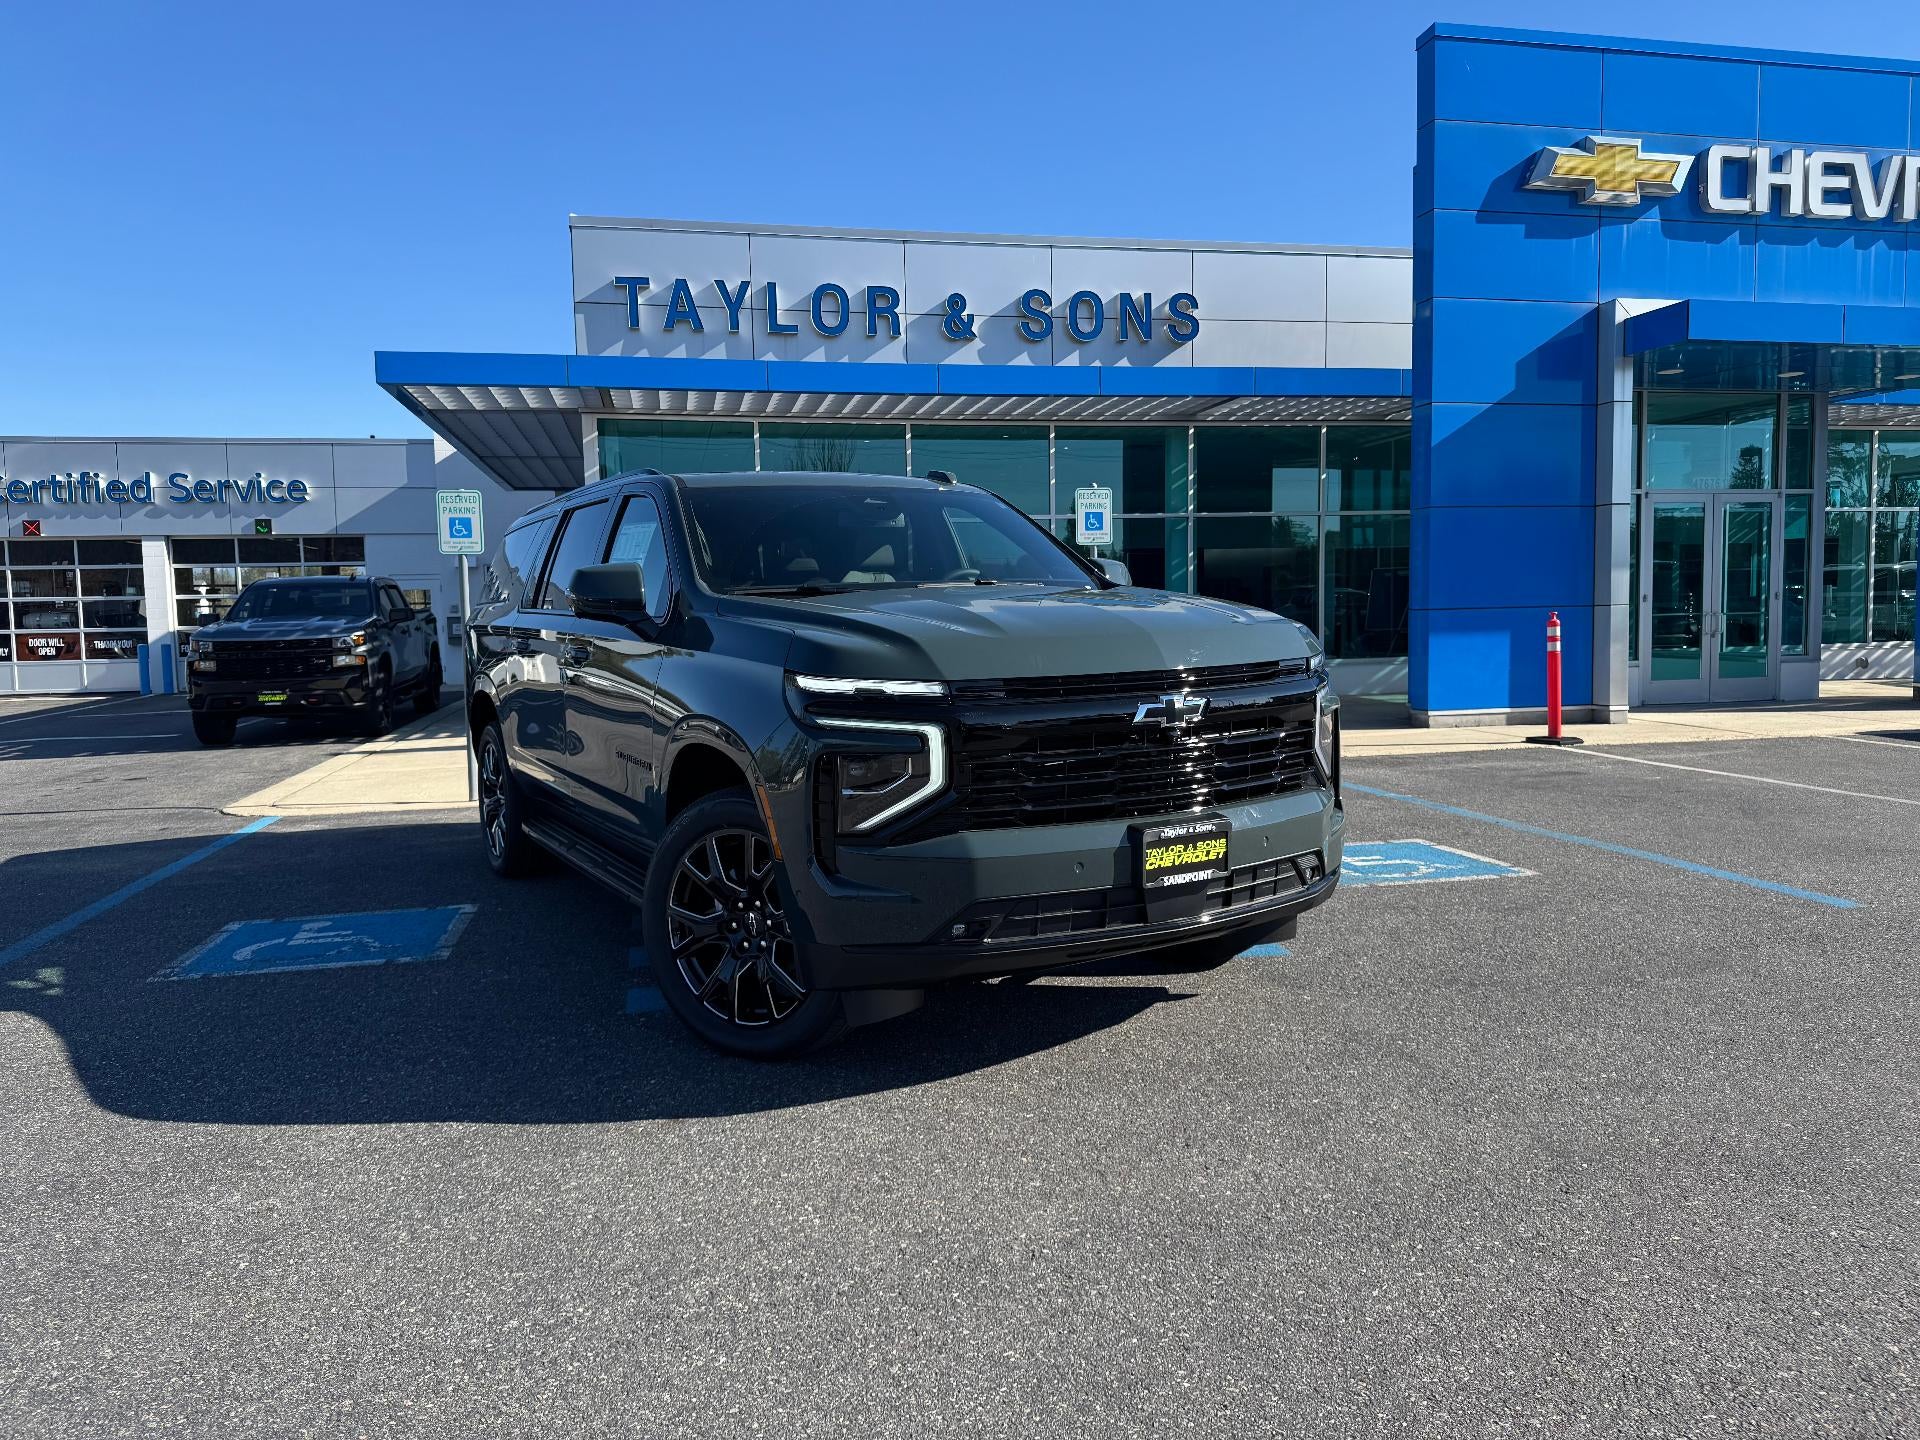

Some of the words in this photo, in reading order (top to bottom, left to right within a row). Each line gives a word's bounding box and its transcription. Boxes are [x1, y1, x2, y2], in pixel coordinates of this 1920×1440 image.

[614, 276, 901, 337] TAYLOR
[942, 292, 978, 340] &
[1017, 289, 1200, 343] SONS
[0, 471, 154, 503] ertified
[168, 472, 309, 503] Service
[440, 495, 478, 504] RESERVED
[1078, 492, 1109, 500] RESERVED
[442, 506, 476, 515] PARKING
[1080, 502, 1107, 510] PARKING
[28, 638, 47, 647] DOOR
[48, 637, 65, 647] WILL
[38, 646, 56, 656] OPEN
[1163, 826, 1187, 838] Taylor
[1195, 823, 1213, 833] Sons
[1145, 845, 1185, 859] TAYLOR
[1187, 843, 1194, 853] &
[1197, 838, 1227, 850] SONS
[1145, 848, 1227, 870] CHEVROLET
[1163, 869, 1212, 887] SANDPOINT
